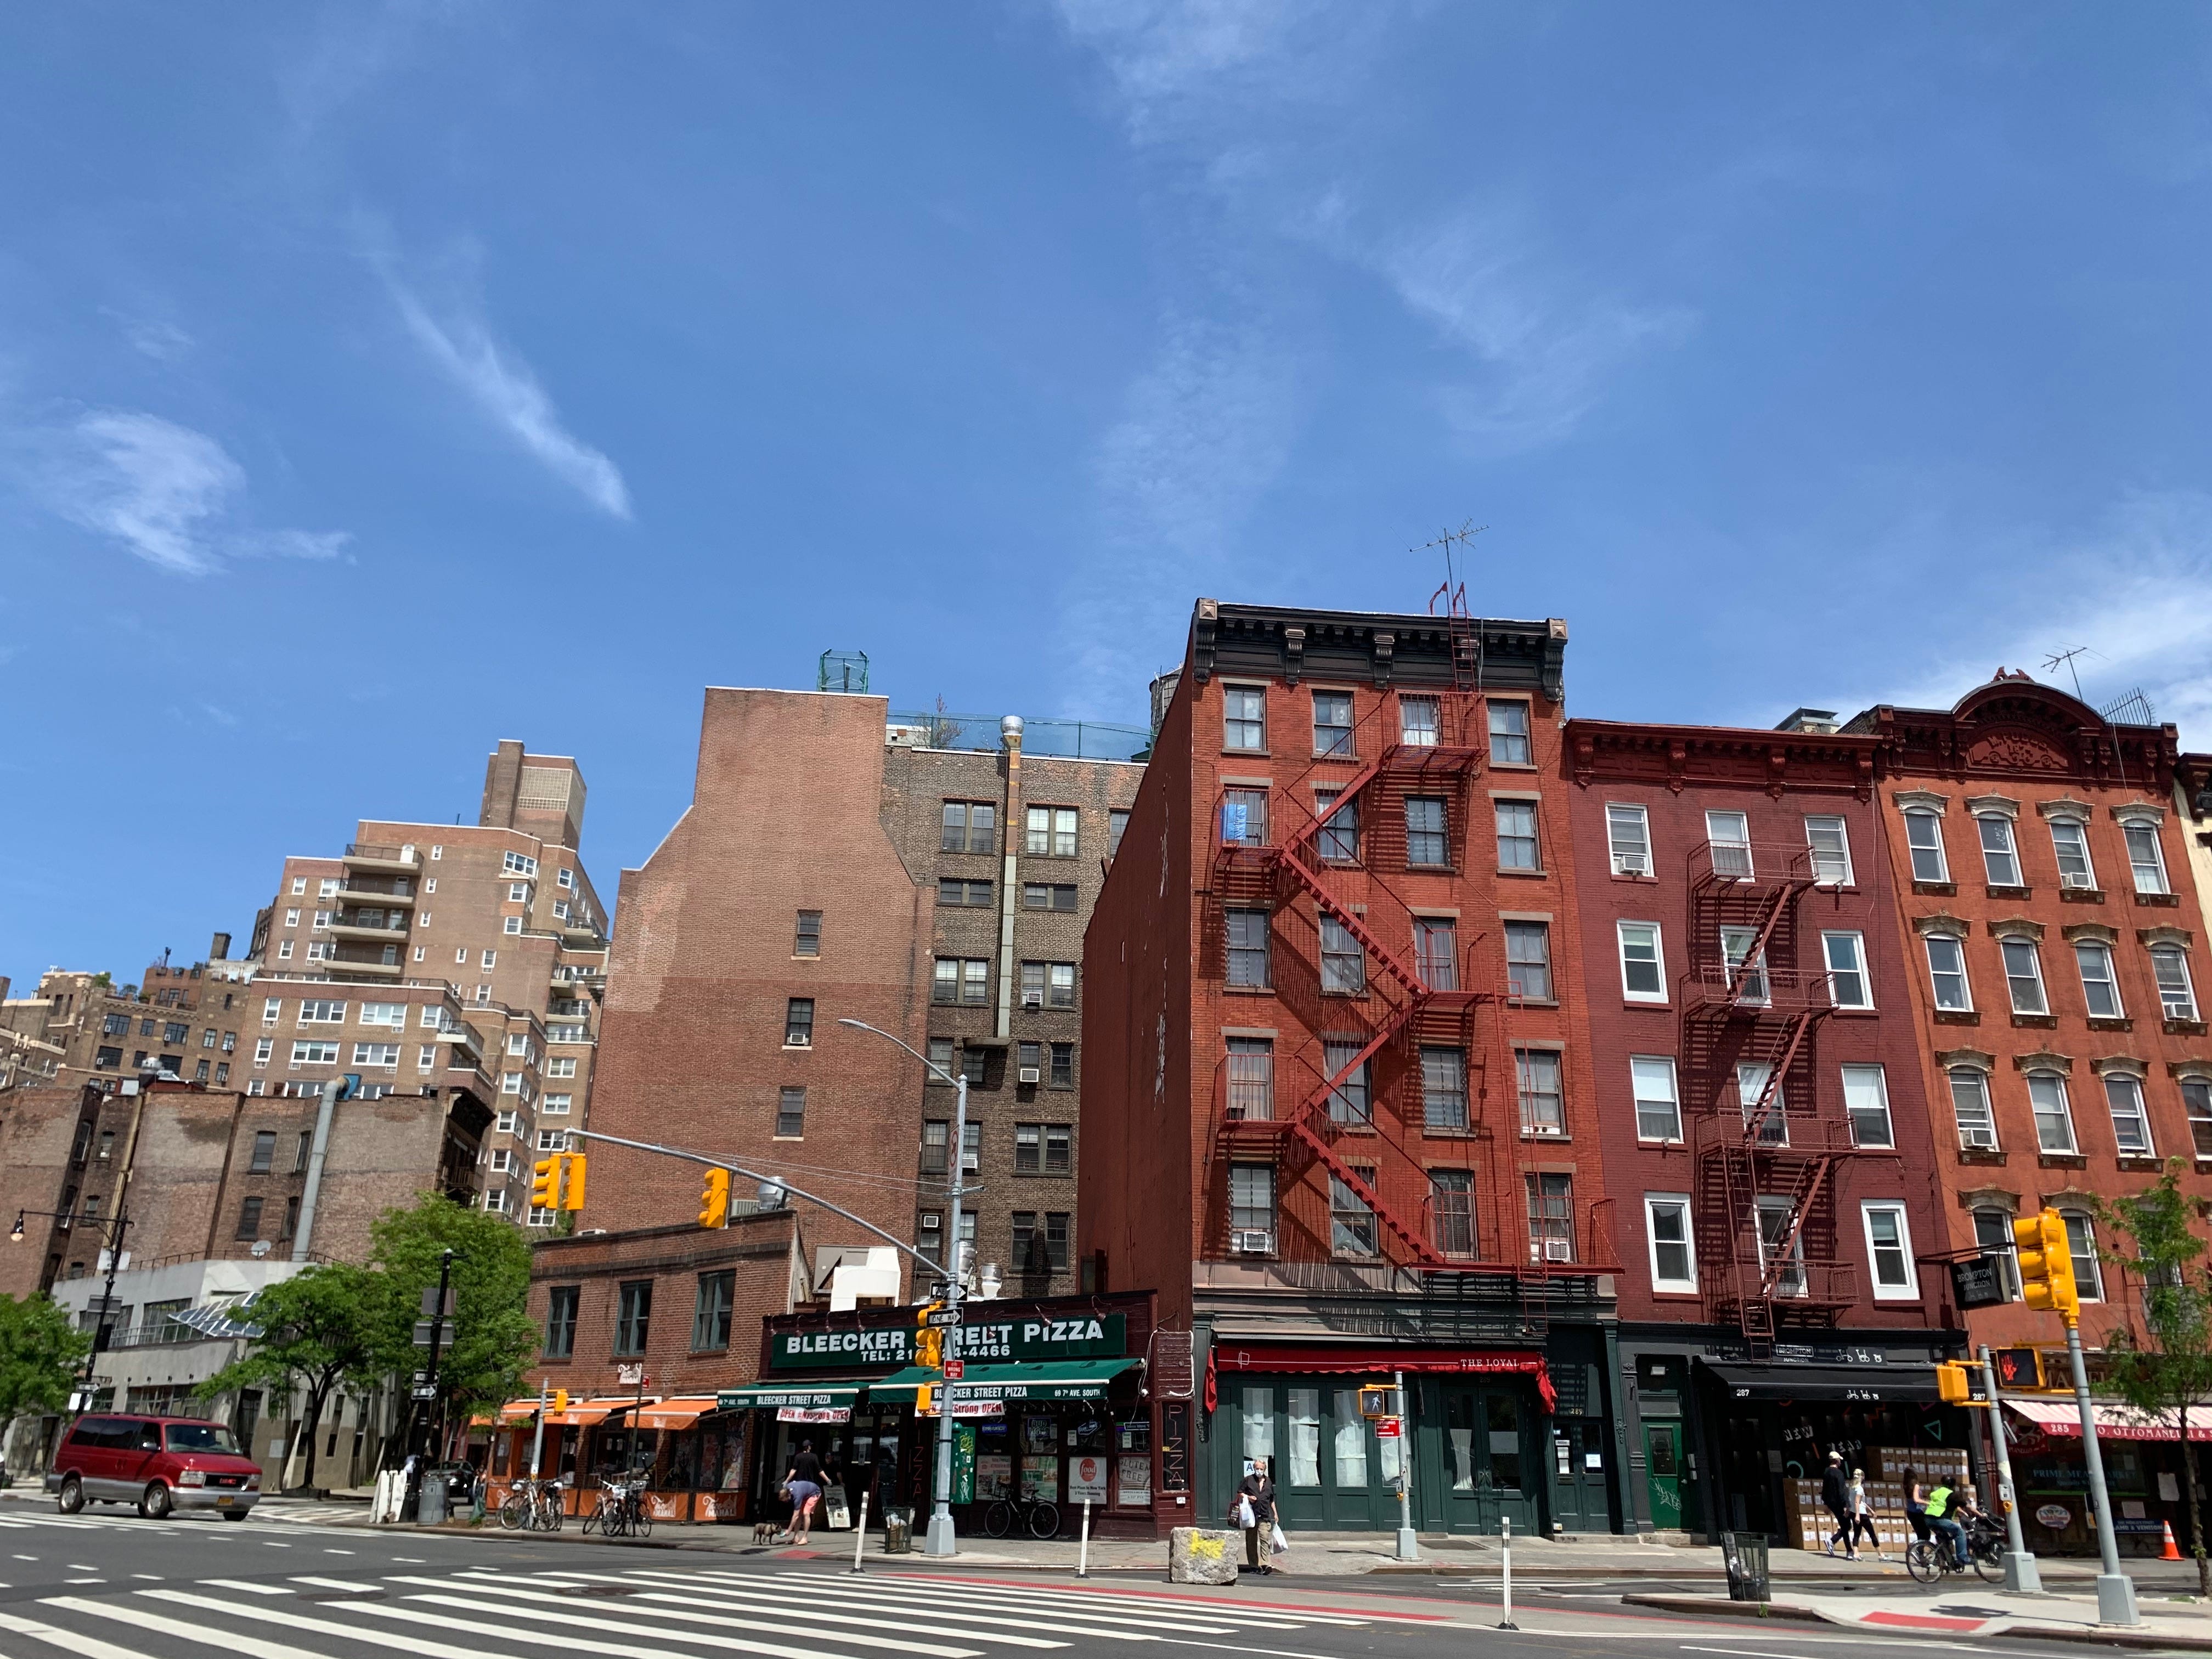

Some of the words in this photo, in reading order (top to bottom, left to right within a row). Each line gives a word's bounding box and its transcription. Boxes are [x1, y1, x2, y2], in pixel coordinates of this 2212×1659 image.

[1957, 1268, 1992, 1283] BROMPTON
[1963, 1280, 1991, 1291] JUNCTION
[787, 1331, 906, 1353] BLEECKER
[1024, 1320, 1103, 1342] PIZZA
[861, 1351, 890, 1362] TEL:
[1486, 1358, 1520, 1367] LOYAL
[934, 1388, 972, 1399] BLCKER
[974, 1387, 1002, 1398] STREET
[1005, 1386, 1028, 1397] PIZZA
[1082, 1389, 1100, 1397] SOUTH
[757, 1395, 787, 1405] BLEECKER
[788, 1395, 811, 1404] STREET
[813, 1395, 831, 1404] PIZZA
[982, 1403, 1002, 1413] OPEN
[780, 1409, 795, 1419] OPEN
[832, 1409, 849, 1420] OPEN
[2051, 1424, 2069, 1433] 285
[2097, 1427, 2110, 1435] O.
[2198, 1430, 2205, 1438] &
[1169, 1405, 1184, 1486] PIZZA
[1081, 1464, 1096, 1475] food
[1246, 1463, 1253, 1471] A
[1122, 1469, 1142, 1482] FREE
[2033, 1469, 2063, 1478] PRIME
[2066, 1470, 2090, 1479] MEA
